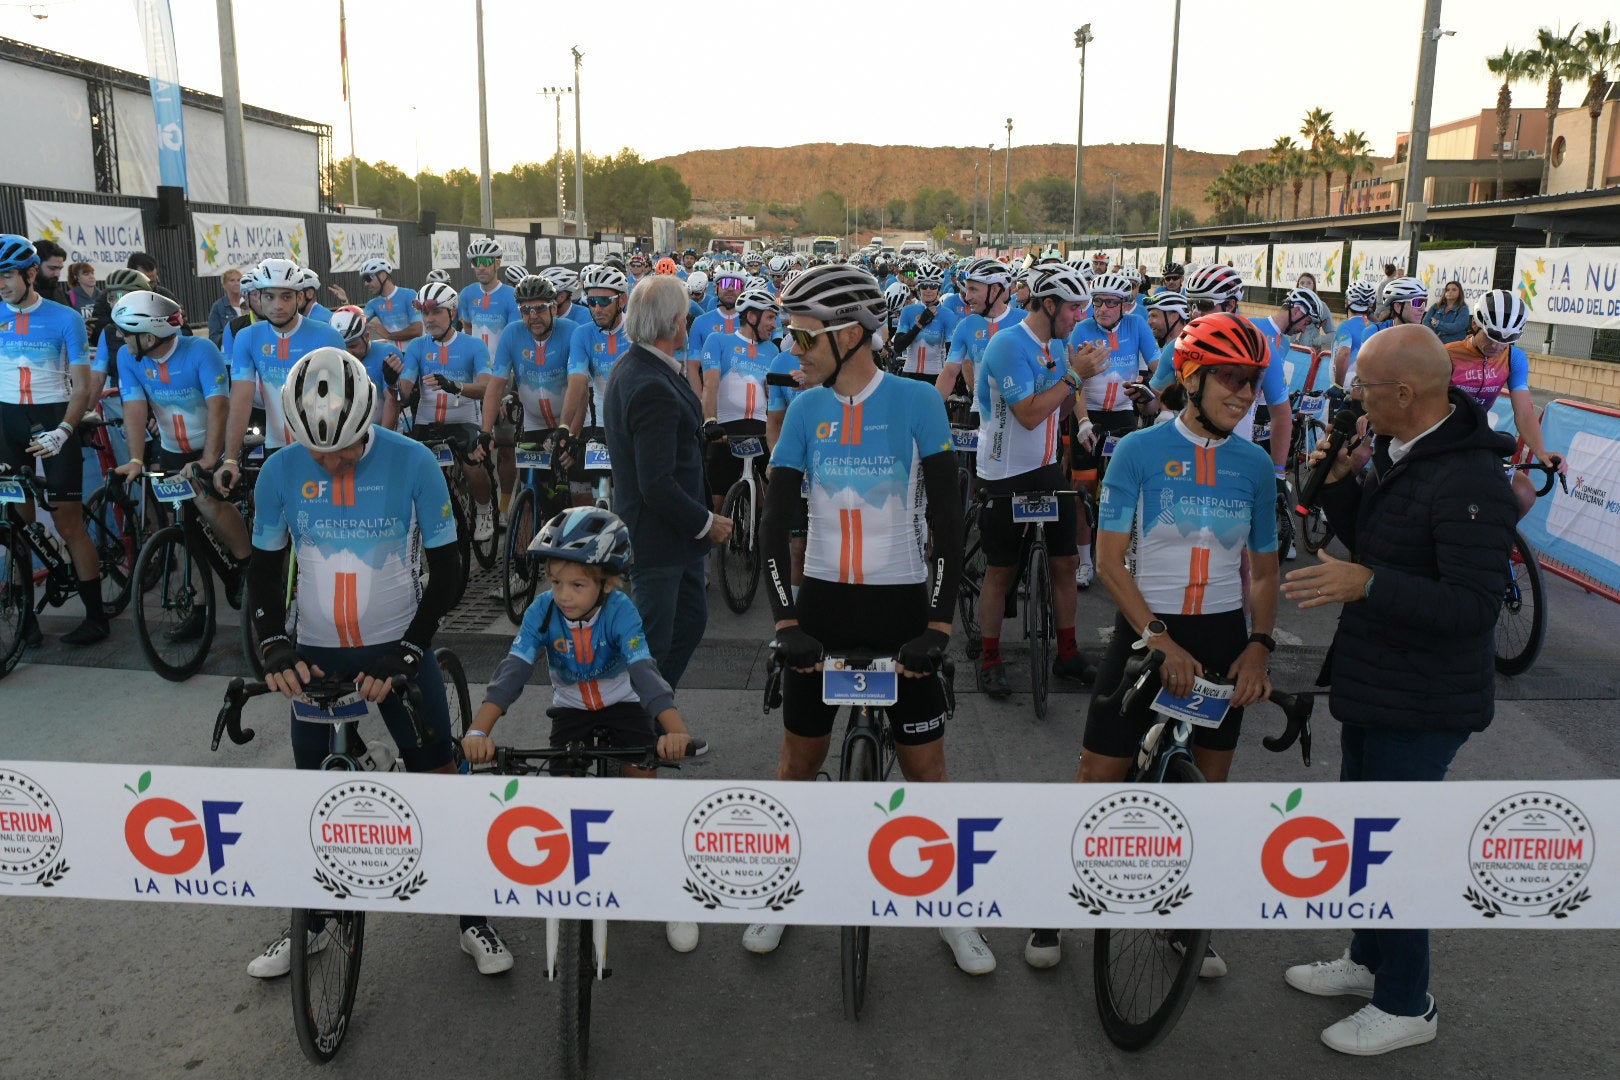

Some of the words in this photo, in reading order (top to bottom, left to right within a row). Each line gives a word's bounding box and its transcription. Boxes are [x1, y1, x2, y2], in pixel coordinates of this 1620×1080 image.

[225, 227, 240, 248] LA
[1286, 253, 1295, 268] LA
[1365, 255, 1374, 270] LA
[1436, 266, 1447, 284] LA
[1550, 262, 1570, 290] LA
[1547, 297, 1583, 313] CIUDAD
[1586, 302, 1604, 315] DEL
[956, 436, 974, 445] 507
[523, 453, 542, 461] 491
[824, 456, 896, 466] GENERALITAT
[824, 467, 894, 476] VALENCIANA
[157, 483, 185, 496] 1042
[1180, 496, 1247, 508] GENERALITAT
[1181, 507, 1247, 519] VALENCIANA
[315, 517, 398, 528] GENERALITAT
[316, 529, 396, 540] VALENCIANA
[853, 672, 867, 692] 3
[1186, 695, 1204, 711] 2
[16, 834, 27, 842] DE
[27, 834, 60, 844] CICLISMO
[124, 797, 244, 876] GF
[321, 823, 413, 845] CRITERIUM
[487, 806, 614, 886] GF
[695, 832, 790, 854] CRITERIUM
[1084, 836, 1182, 858] CRITERIUM
[1482, 838, 1583, 860] CRITERIUM
[316, 846, 373, 855] INTERNACIONAL
[374, 847, 385, 855] DE
[385, 848, 419, 856] CICLISMO
[868, 815, 1003, 897] GF
[1261, 816, 1401, 899] GF
[688, 855, 748, 864] INTERNACIONAL
[749, 856, 760, 865] DE
[761, 856, 797, 865] CICLISMO
[1076, 859, 1138, 869] INTERNACIONAL
[1139, 859, 1151, 868] DE
[1151, 860, 1188, 869] CICLISMO
[1473, 862, 1535, 871] INTERNACIONAL
[1537, 862, 1548, 871] DE
[1550, 862, 1588, 871] CICLISMO
[720, 869, 730, 877] LA
[135, 878, 160, 893] LA
[494, 888, 520, 905] LA
[872, 900, 898, 916] LA
[1261, 902, 1288, 919] LA
